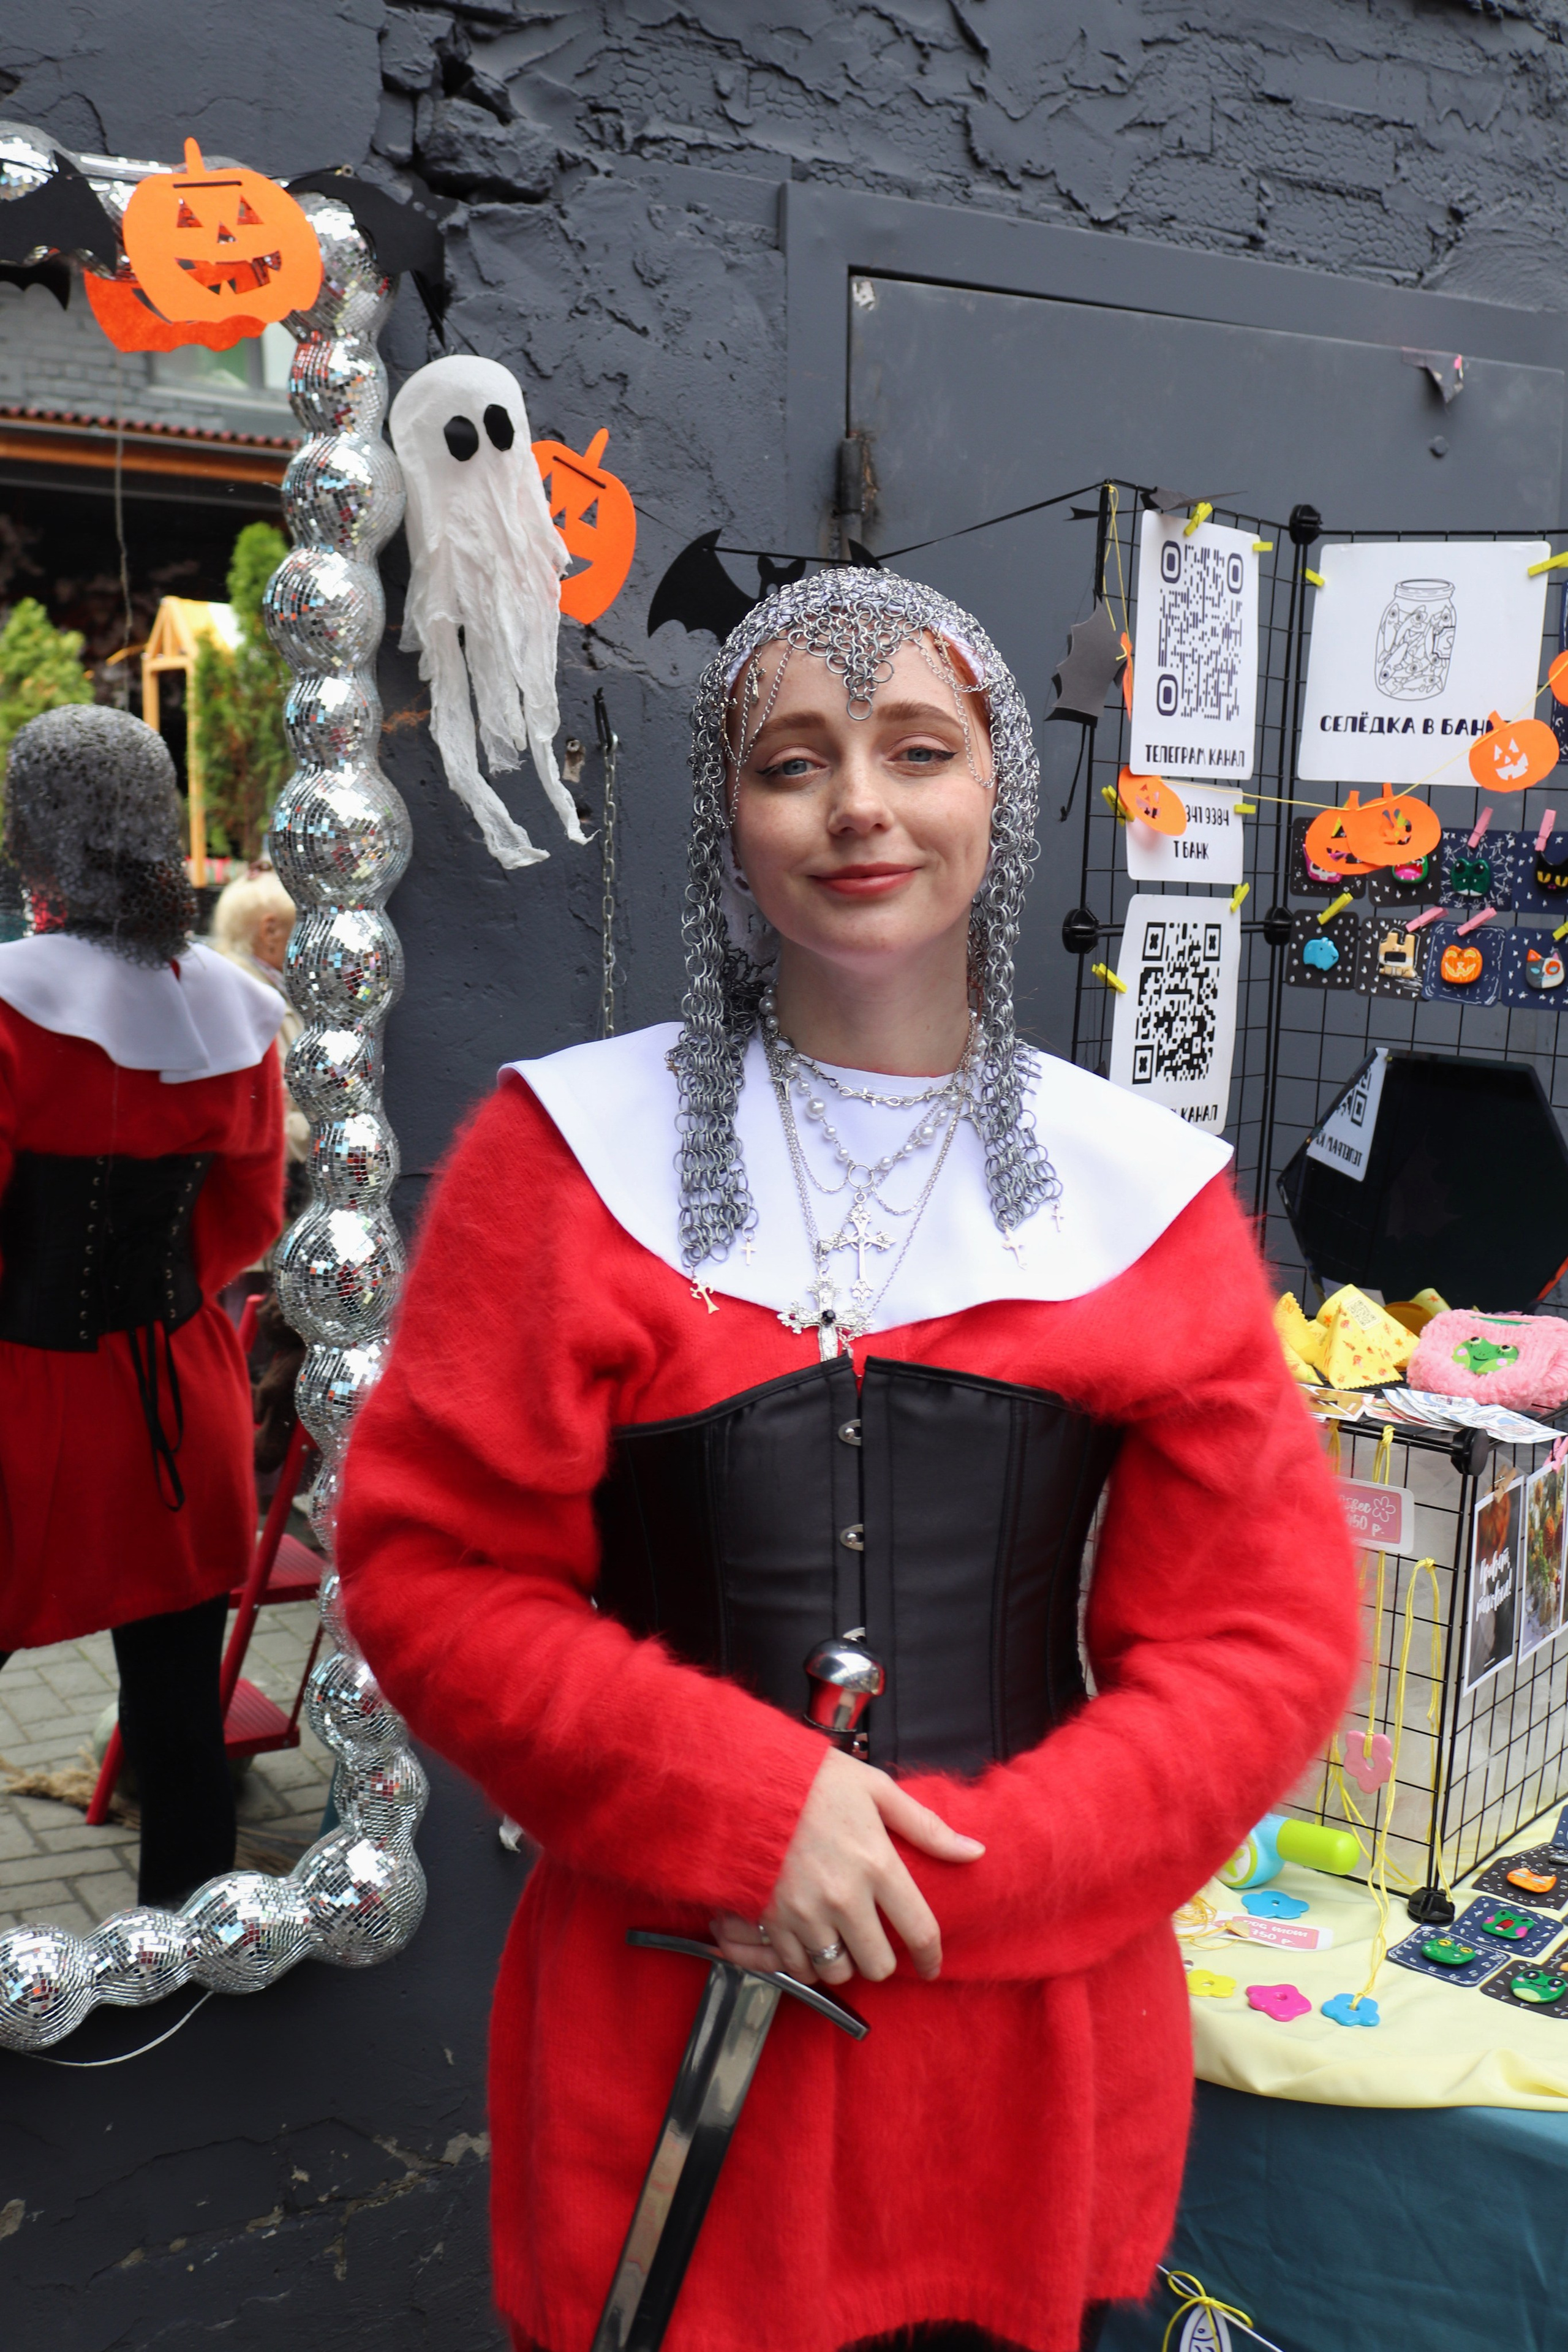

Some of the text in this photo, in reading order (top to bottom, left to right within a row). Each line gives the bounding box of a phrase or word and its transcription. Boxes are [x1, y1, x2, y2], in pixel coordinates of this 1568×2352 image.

[1320, 711, 1511, 736] СЕЛЁДКА В БАН
[1145, 744, 1245, 767] ТЕЛЕГРАМ КАНАЛ
[1205, 807, 1229, 826] 9384
[1173, 840, 1209, 860] Т БАНК
[1181, 1104, 1218, 1123] КАНАЛ
